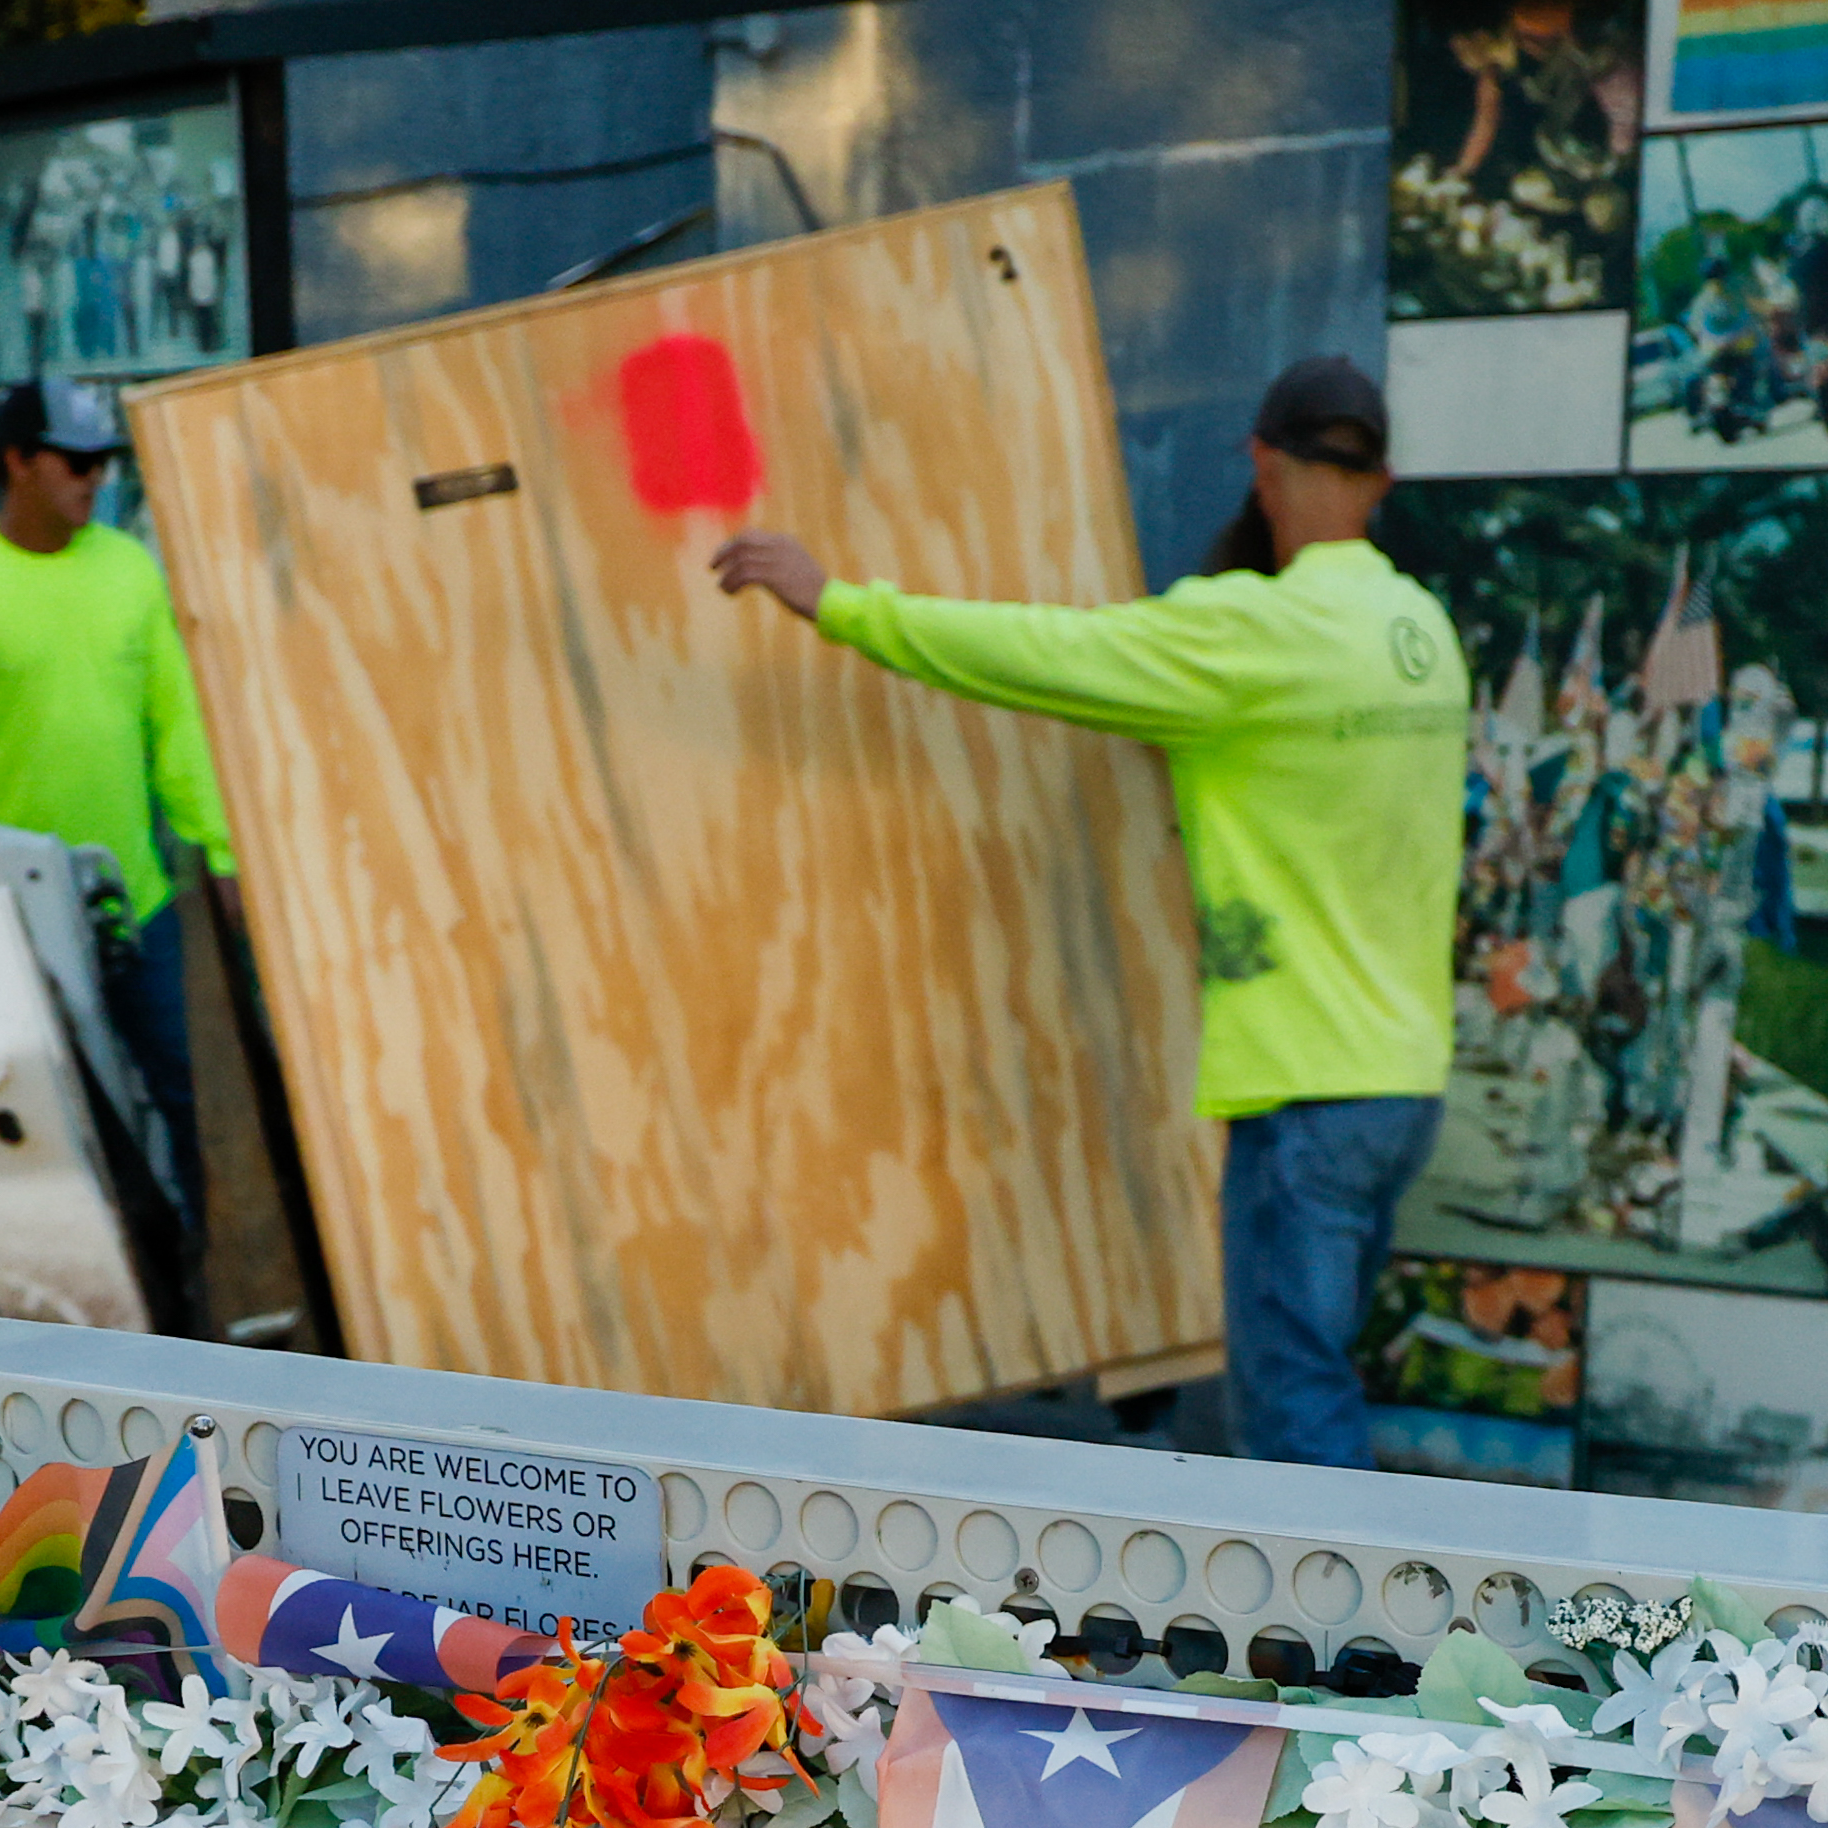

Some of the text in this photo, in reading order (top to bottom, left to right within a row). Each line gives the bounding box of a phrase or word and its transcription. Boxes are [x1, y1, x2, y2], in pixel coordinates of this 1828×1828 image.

[299, 1434, 636, 1503] YOU ARE WELCOME TO
[322, 1476, 617, 1541] LEAVE FLOWERS OR
[341, 1518, 599, 1579] OFFERINGS HERE.
